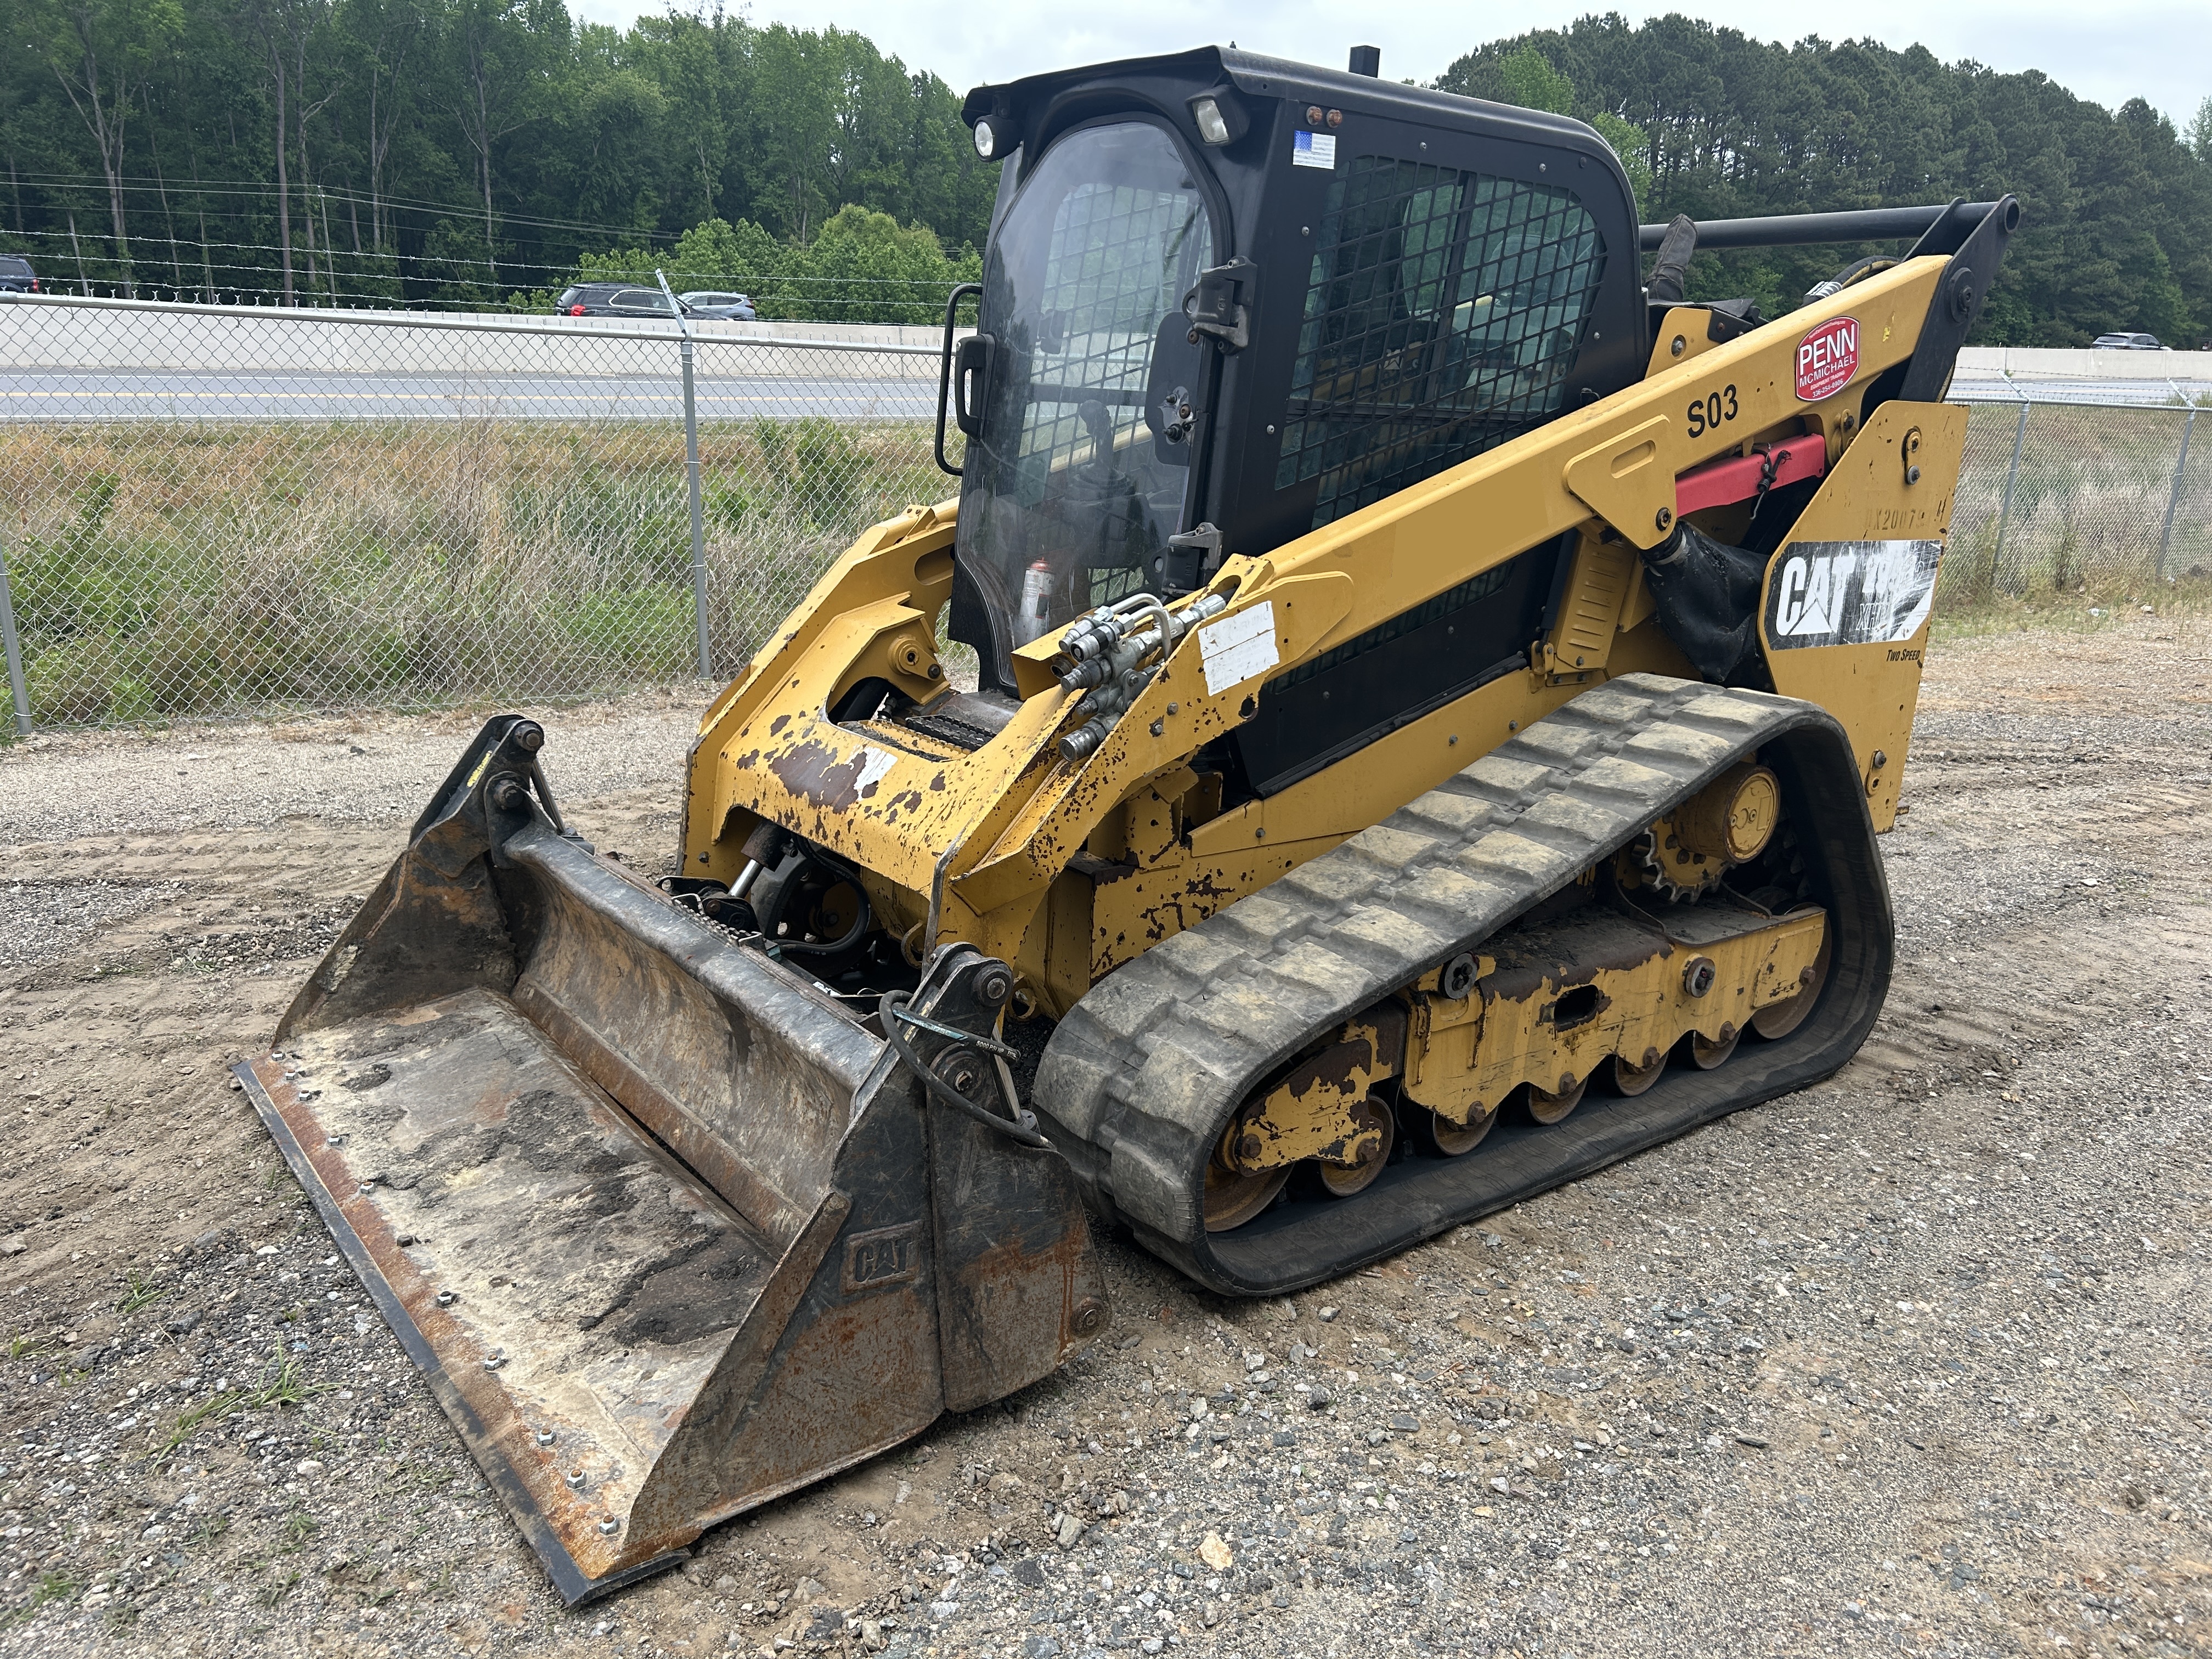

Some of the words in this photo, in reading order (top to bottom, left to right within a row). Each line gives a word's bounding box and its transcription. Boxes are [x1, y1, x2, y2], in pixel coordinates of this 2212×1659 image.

[1799, 323, 1855, 376] PENN
[1799, 354, 1855, 388] MCMICHAEL
[1687, 384, 1738, 438] S03
[1776, 556, 1856, 636] CAT
[976, 1040, 990, 1049] 5000
[855, 1237, 911, 1283] CAT
